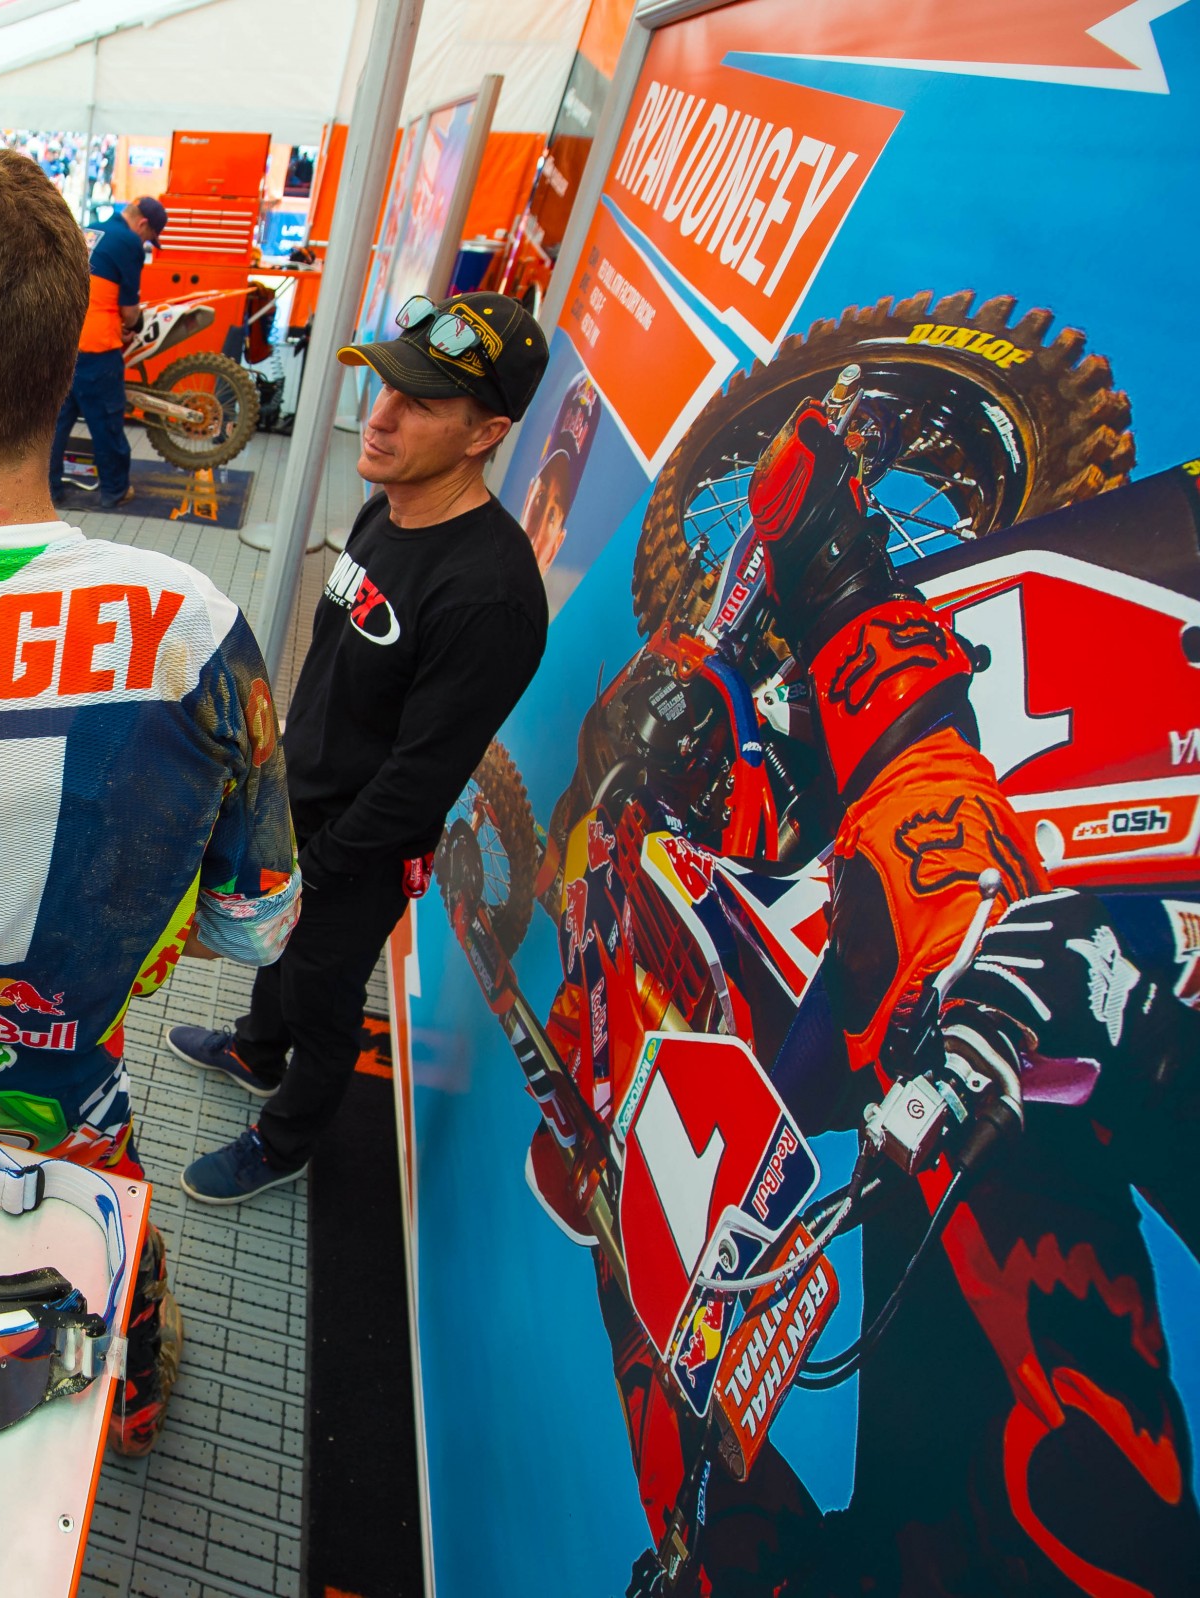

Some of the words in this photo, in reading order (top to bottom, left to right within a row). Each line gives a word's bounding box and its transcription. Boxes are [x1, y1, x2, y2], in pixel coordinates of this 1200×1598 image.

[615, 81, 706, 211] RYAN
[662, 103, 859, 298] DUNGEY
[905, 324, 1033, 369] DUNLOP
[723, 582, 750, 627] DID
[649, 681, 677, 706] HINSON
[953, 587, 1070, 783] 1
[1112, 809, 1169, 834] 450
[590, 976, 606, 1021] Red
[593, 1008, 608, 1057] Bull
[619, 1059, 651, 1133] MOTOREX
[633, 1068, 727, 1280] 1
[770, 1125, 799, 1183] Red
[751, 1165, 780, 1222] Bull
[741, 1265, 829, 1438] RENTHAL
